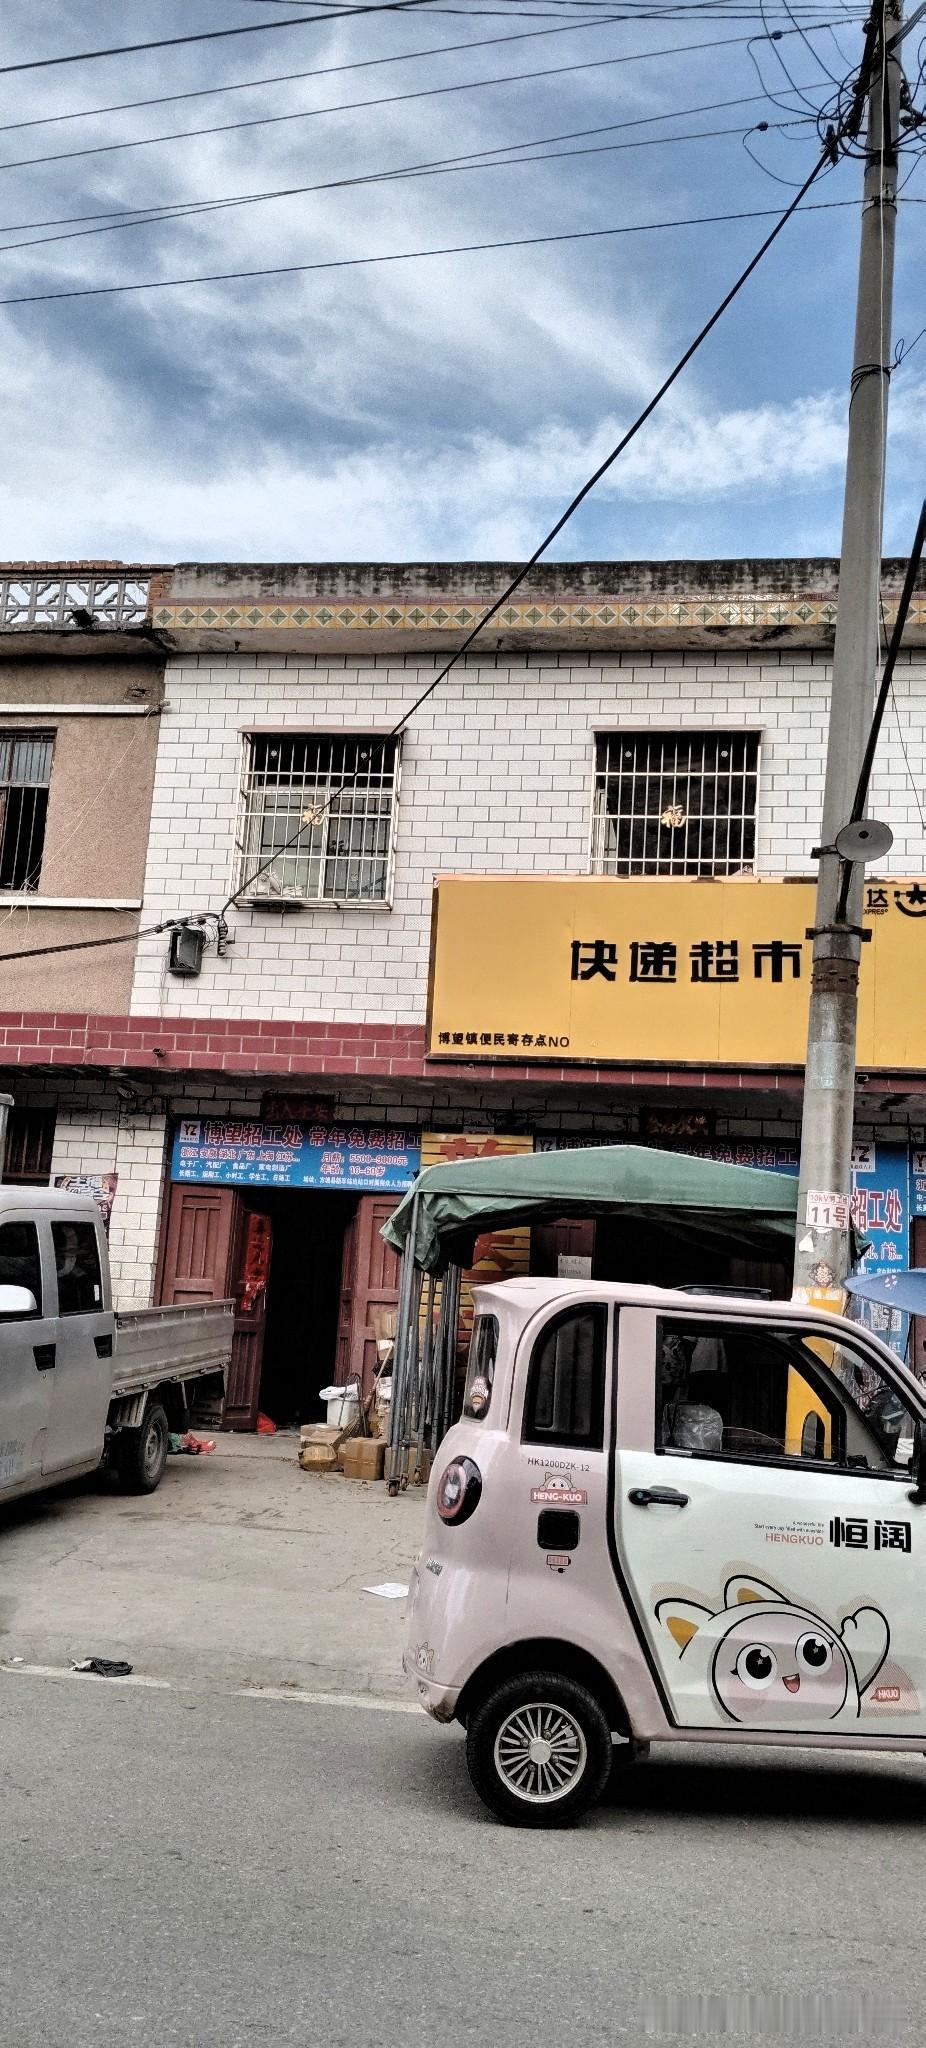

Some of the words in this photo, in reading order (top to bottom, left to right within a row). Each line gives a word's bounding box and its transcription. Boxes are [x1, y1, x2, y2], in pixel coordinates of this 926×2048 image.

[570, 939, 803, 983] 快递超市
[183, 1123, 198, 1136] YZ
[204, 1120, 303, 1149] 博望招工处
[309, 1126, 422, 1150] 常年免费招工
[811, 1206, 847, 1228] 11号
[527, 1457, 590, 1472] HK1200DZK-12
[533, 1491, 582, 1502] HENG-KUO
[765, 1533, 824, 1546] HENGKUO
[829, 1516, 912, 1554] 恒阔
[878, 1688, 898, 1698] HKUO
